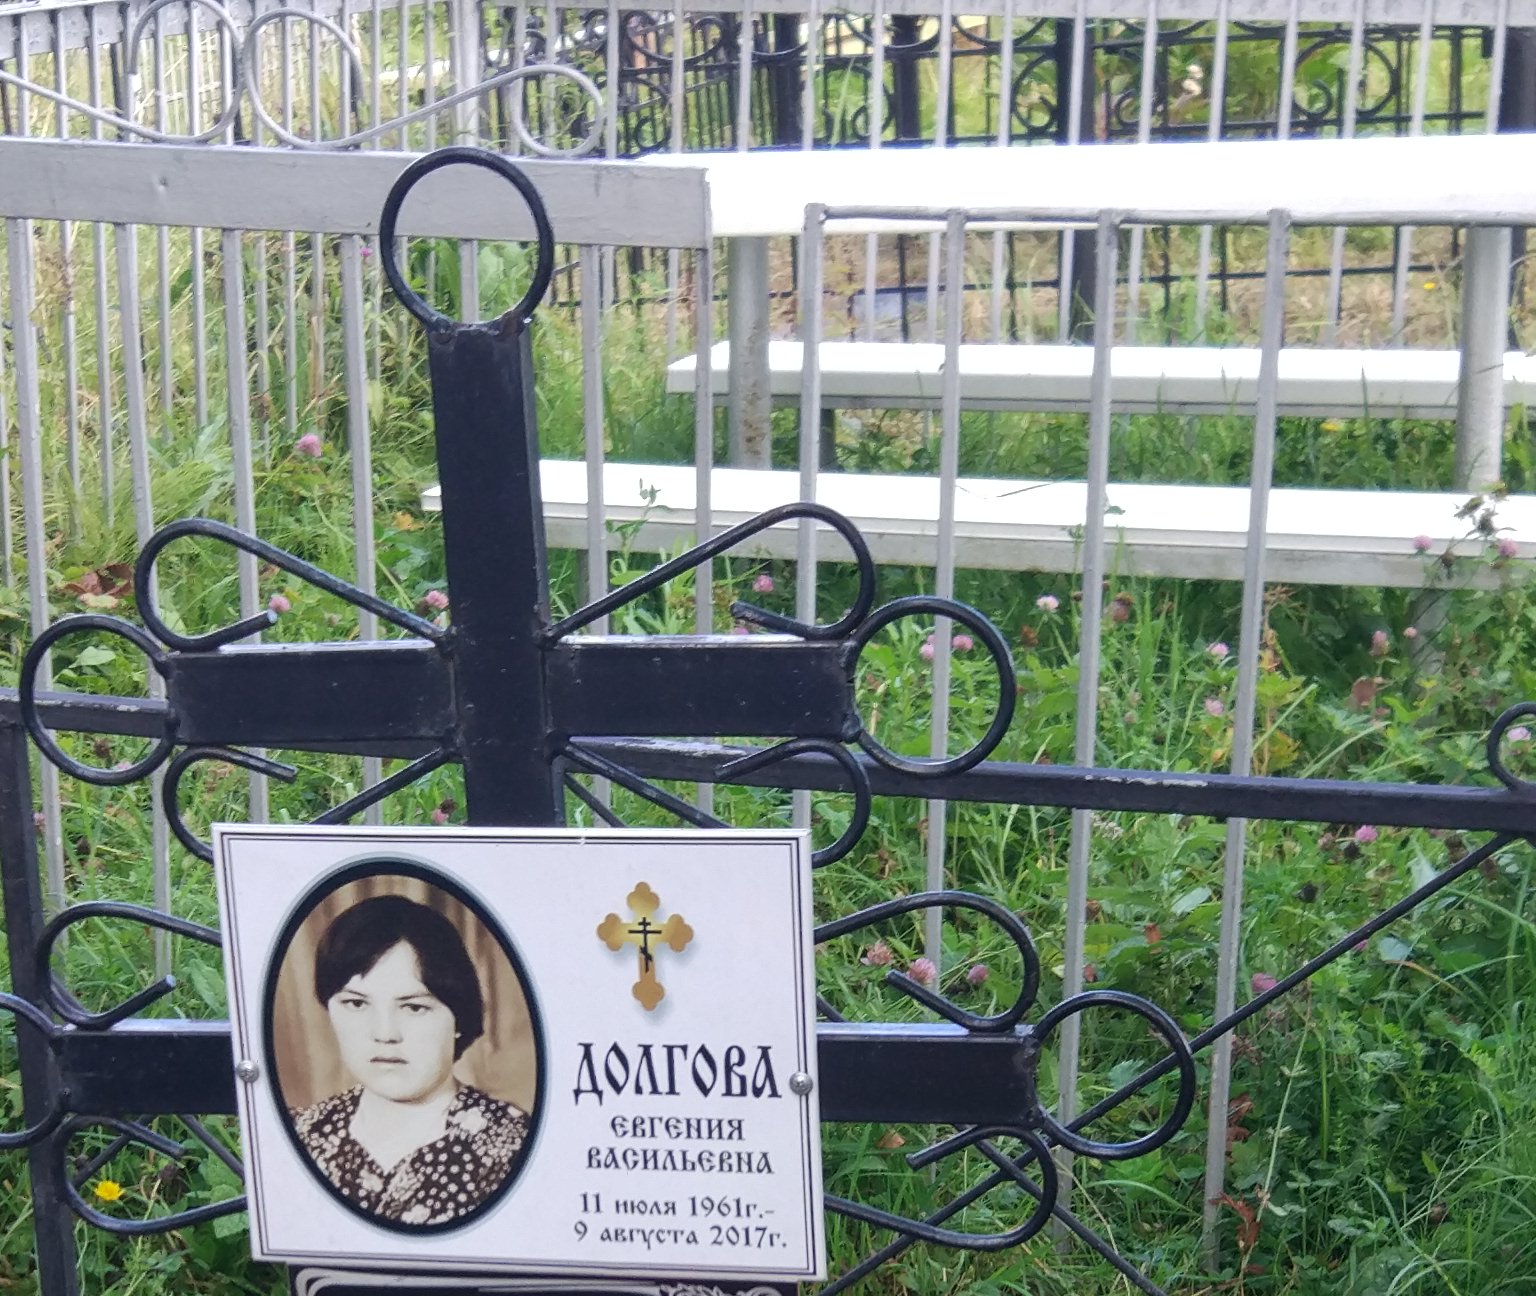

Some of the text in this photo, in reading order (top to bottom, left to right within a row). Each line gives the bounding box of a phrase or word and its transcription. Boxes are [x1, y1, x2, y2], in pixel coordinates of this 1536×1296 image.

[573, 1041, 782, 1106] ДОЛГОВА
[610, 1114, 746, 1141] ЕВГЕНИЯ
[585, 1146, 776, 1175] ВАСИЛЬЕВНА
[580, 1192, 603, 1214] 11
[615, 1199, 677, 1216] июля
[573, 1220, 787, 1250] 9 августа 2017г.
